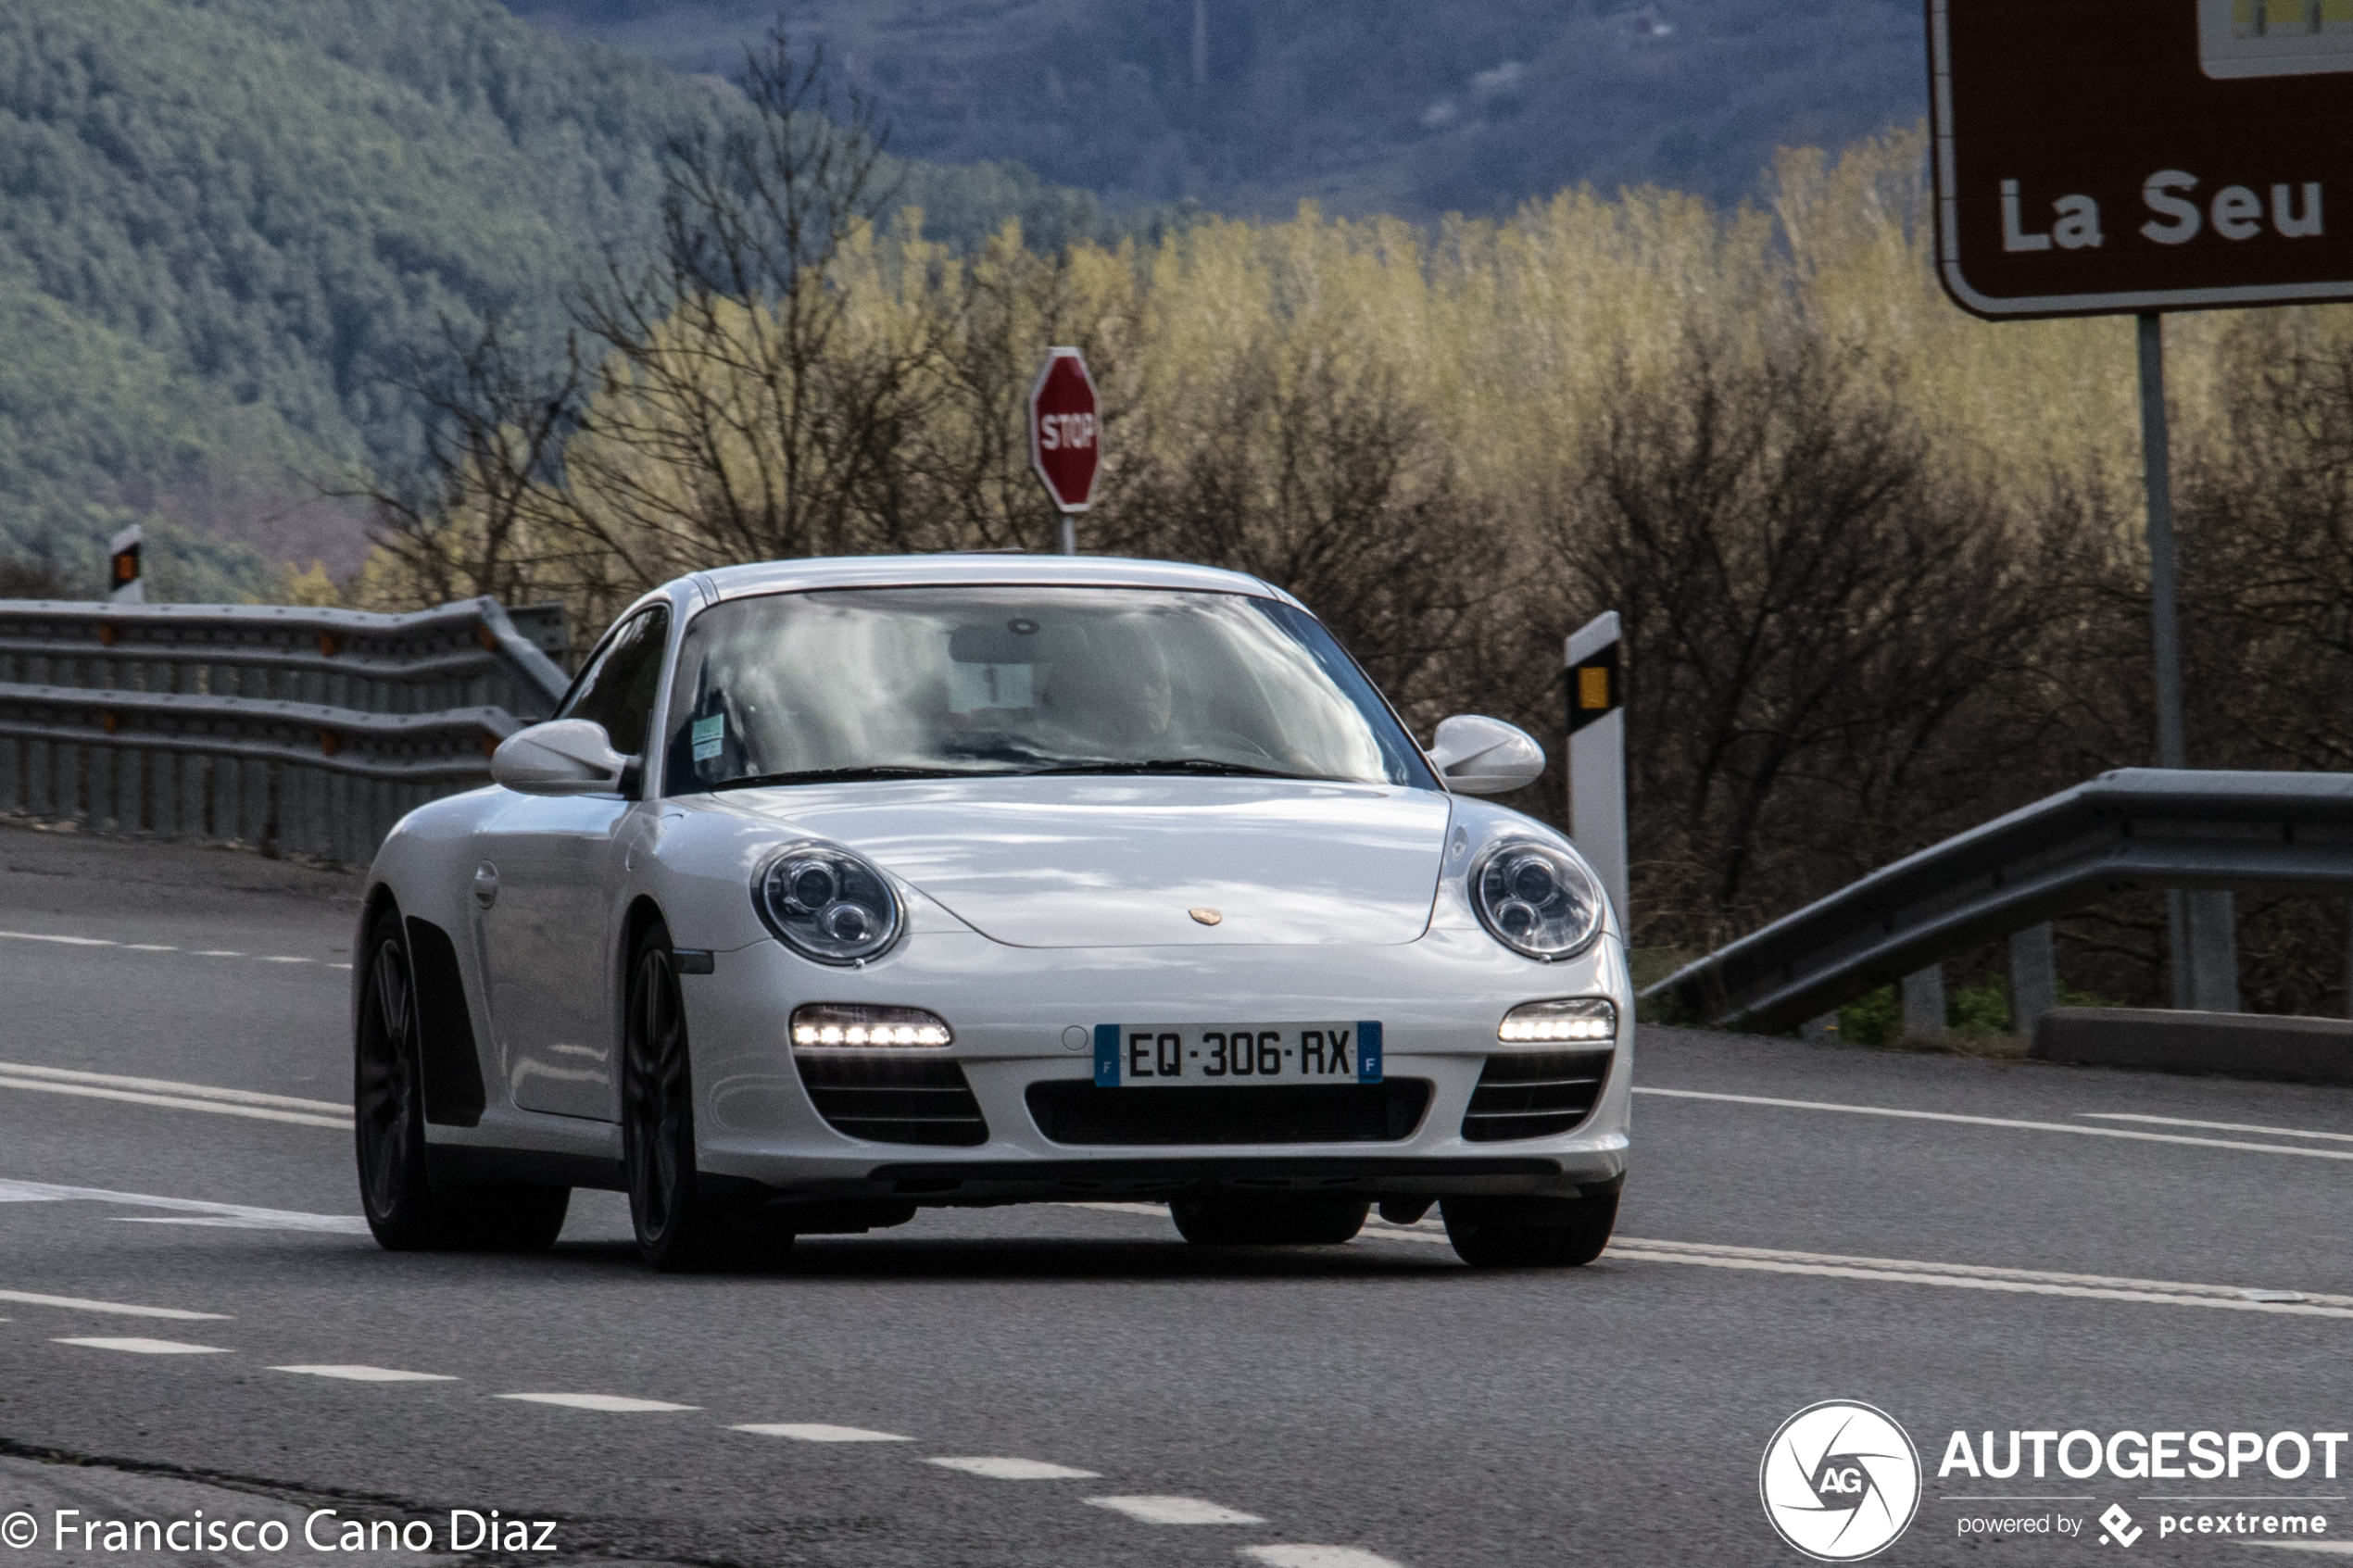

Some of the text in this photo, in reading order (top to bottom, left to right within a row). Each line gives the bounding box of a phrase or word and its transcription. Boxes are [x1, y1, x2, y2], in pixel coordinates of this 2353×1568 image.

[2000, 169, 2323, 252] La Seu
[1040, 413, 1094, 450] STOP
[1103, 1061, 1112, 1073] F
[1365, 1058, 1376, 1072] F
